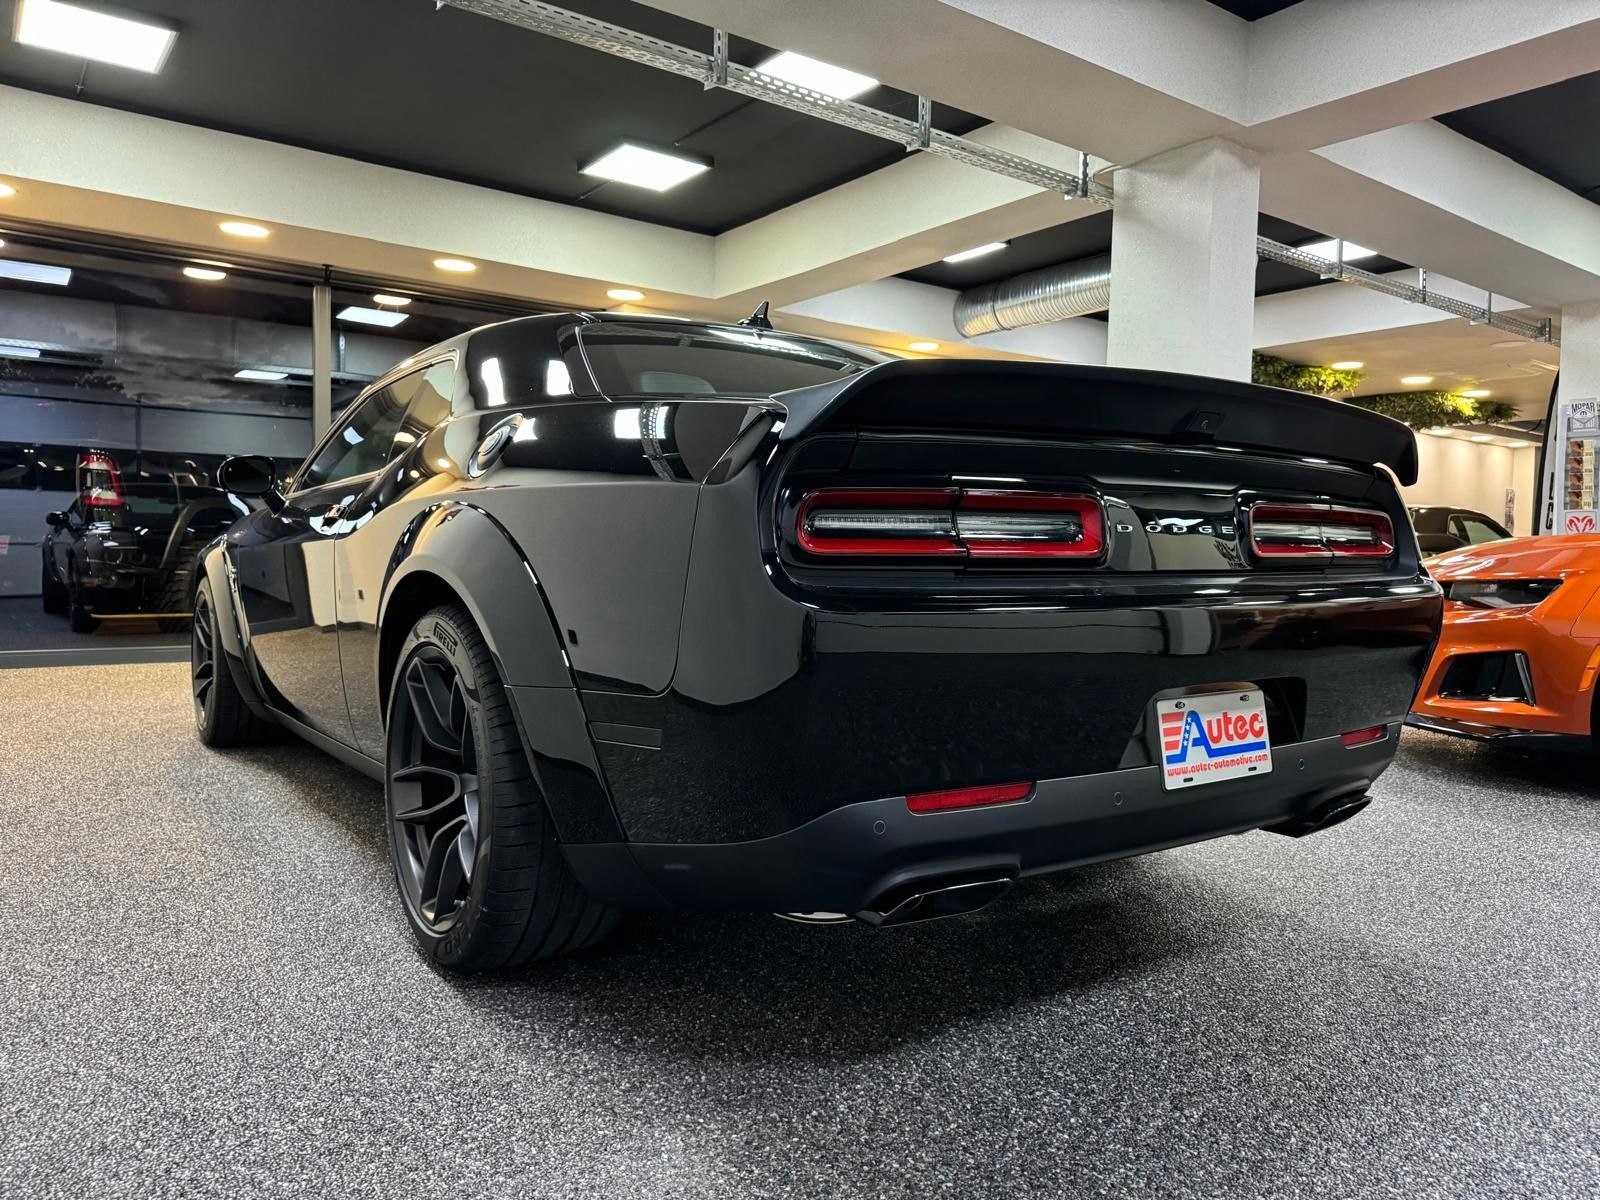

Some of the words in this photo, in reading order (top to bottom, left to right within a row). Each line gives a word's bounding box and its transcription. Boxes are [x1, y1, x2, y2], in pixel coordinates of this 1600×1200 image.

[1571, 402, 1596, 414] MOPAR
[1116, 523, 1235, 535] DODGE
[433, 621, 459, 657] PIRELLI
[1166, 709, 1266, 762] Autec
[1166, 753, 1269, 777] www.autec-automotive.com
